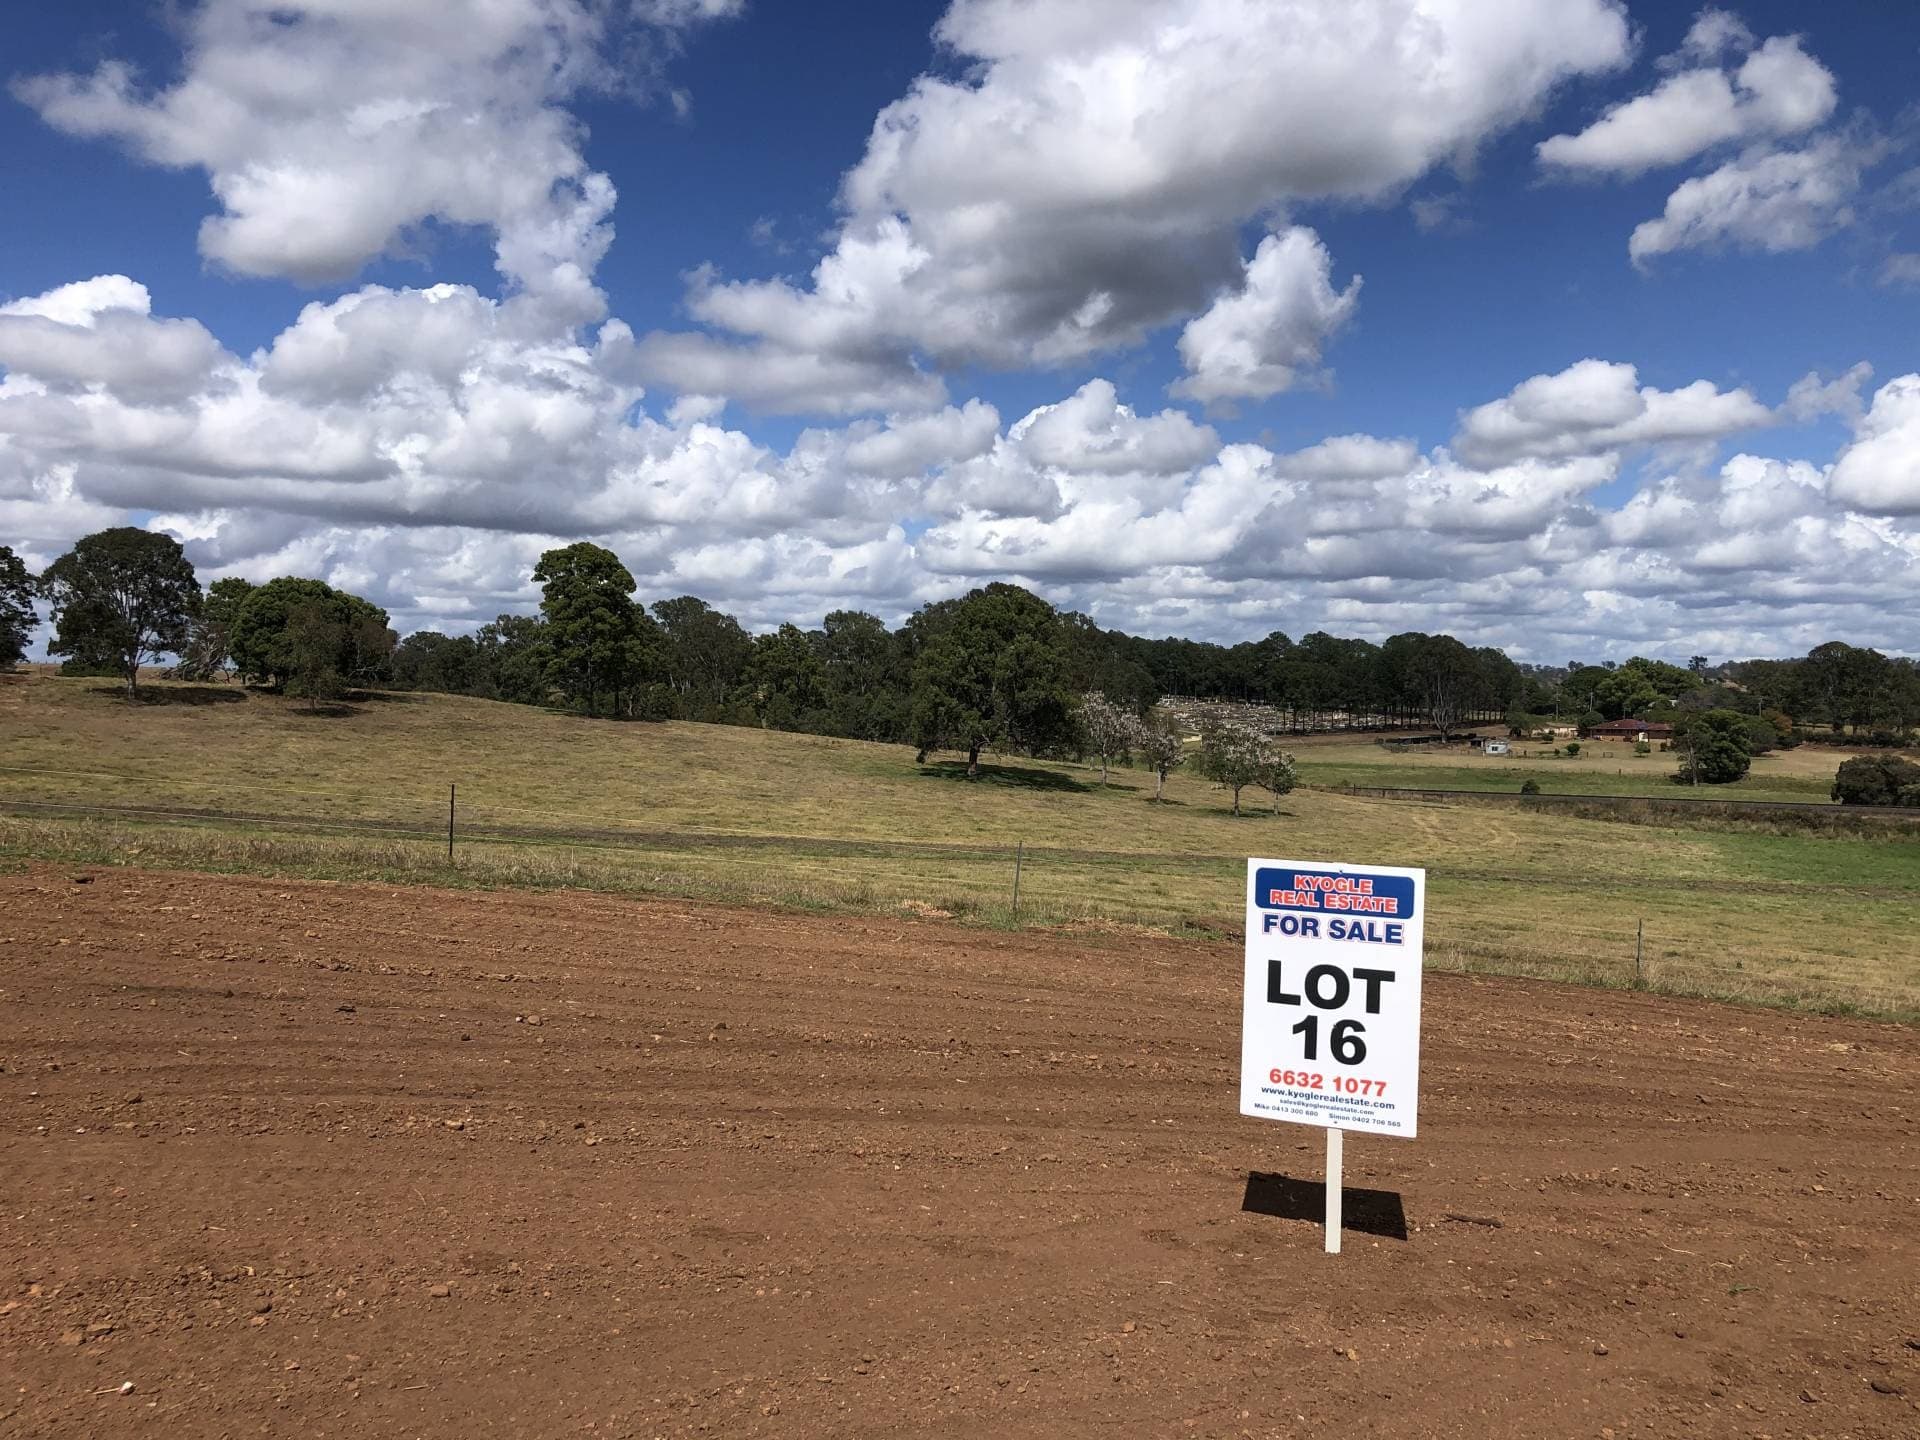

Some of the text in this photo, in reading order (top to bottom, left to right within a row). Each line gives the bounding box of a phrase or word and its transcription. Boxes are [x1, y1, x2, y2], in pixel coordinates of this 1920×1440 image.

[1294, 874, 1373, 894] KYOGLE
[1270, 889, 1398, 913] REAL ESTATE
[1263, 913, 1403, 944] FOR SALE
[1267, 959, 1396, 1014] LOT
[1292, 1015, 1367, 1066] 16
[1269, 1068, 1387, 1097] 6632 1077
[1254, 1102, 1270, 1110] Mike
[1272, 1105, 1289, 1113] 0413
[1261, 1087, 1395, 1110] www.kyoglerealestate.com
[1328, 1113, 1350, 1121] Simon
[1352, 1116, 1370, 1124] 0402
